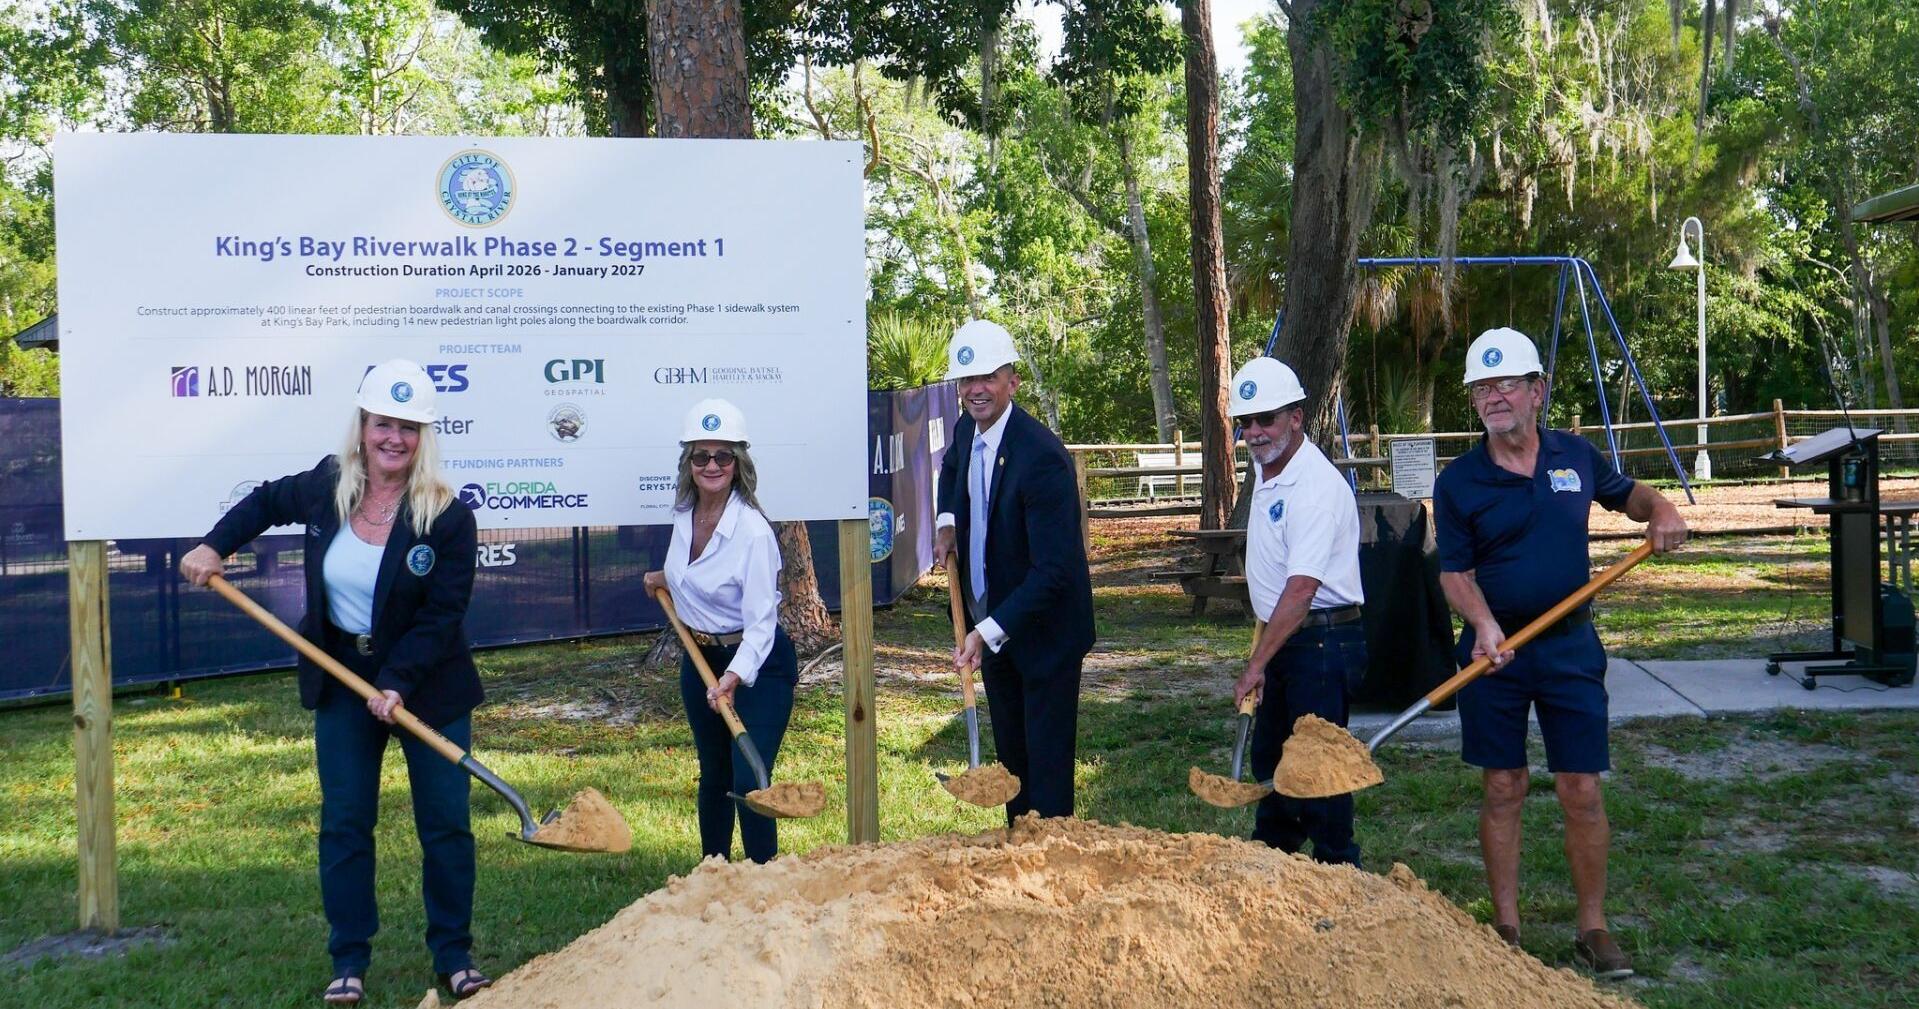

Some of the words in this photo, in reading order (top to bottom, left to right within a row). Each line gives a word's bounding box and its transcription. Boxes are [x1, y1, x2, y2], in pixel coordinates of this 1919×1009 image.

[452, 154, 479, 169] CITY
[485, 157, 498, 168] OF
[441, 191, 482, 223] CRYSTAL
[488, 191, 511, 220] RIVER
[300, 236, 346, 262] Bay
[353, 236, 478, 257] Riverwalk
[485, 236, 557, 257] Phase
[564, 237, 578, 257] 2
[599, 237, 706, 262] Segment
[714, 238, 724, 257] 1
[306, 264, 399, 277] Construction
[403, 264, 465, 277] Duration
[469, 264, 503, 280] April
[507, 265, 541, 277] 2026
[553, 264, 608, 280] January
[611, 265, 644, 277] 2027
[436, 288, 485, 298] PROJECT
[488, 288, 524, 298] SCOPE
[137, 306, 187, 316] Construct
[191, 306, 264, 318] approximately
[267, 306, 286, 315] 400
[289, 305, 316, 315] linear
[319, 305, 338, 315] feet
[341, 305, 351, 315] of
[354, 305, 407, 317] pedestrian
[410, 305, 461, 315] boardwalk
[464, 305, 482, 315] and
[485, 304, 511, 314] canal
[513, 305, 558, 316] crossings
[560, 304, 614, 316] connecting
[617, 305, 628, 314] to
[629, 304, 645, 314] the
[647, 303, 684, 316] existing
[687, 303, 715, 313] Phase
[718, 304, 722, 312] 1
[725, 303, 765, 313] sidewalk
[767, 304, 800, 315] system
[261, 318, 271, 326] at
[306, 317, 323, 328] Bay
[326, 317, 350, 328] Park,
[353, 317, 400, 328] including
[403, 317, 414, 326] 14
[441, 316, 493, 327] pedestrian
[495, 316, 518, 328] light
[520, 316, 546, 327] poles
[548, 315, 576, 327] along
[578, 315, 595, 325] the
[597, 315, 647, 325] boardwalk
[649, 314, 689, 325] corridor.
[440, 344, 487, 354] PROJECT
[490, 344, 521, 354] TEAM
[544, 359, 604, 384] GPI
[654, 367, 707, 384] GBHM
[208, 366, 238, 396] A.D.
[246, 365, 311, 396] MORGAN
[453, 459, 504, 469] FUNDING
[507, 458, 564, 469] PARTNERS
[486, 482, 557, 495] FLORIDA
[640, 483, 678, 491] CRYSTA
[487, 494, 588, 510] COMMERCE
[476, 544, 517, 567] RES
